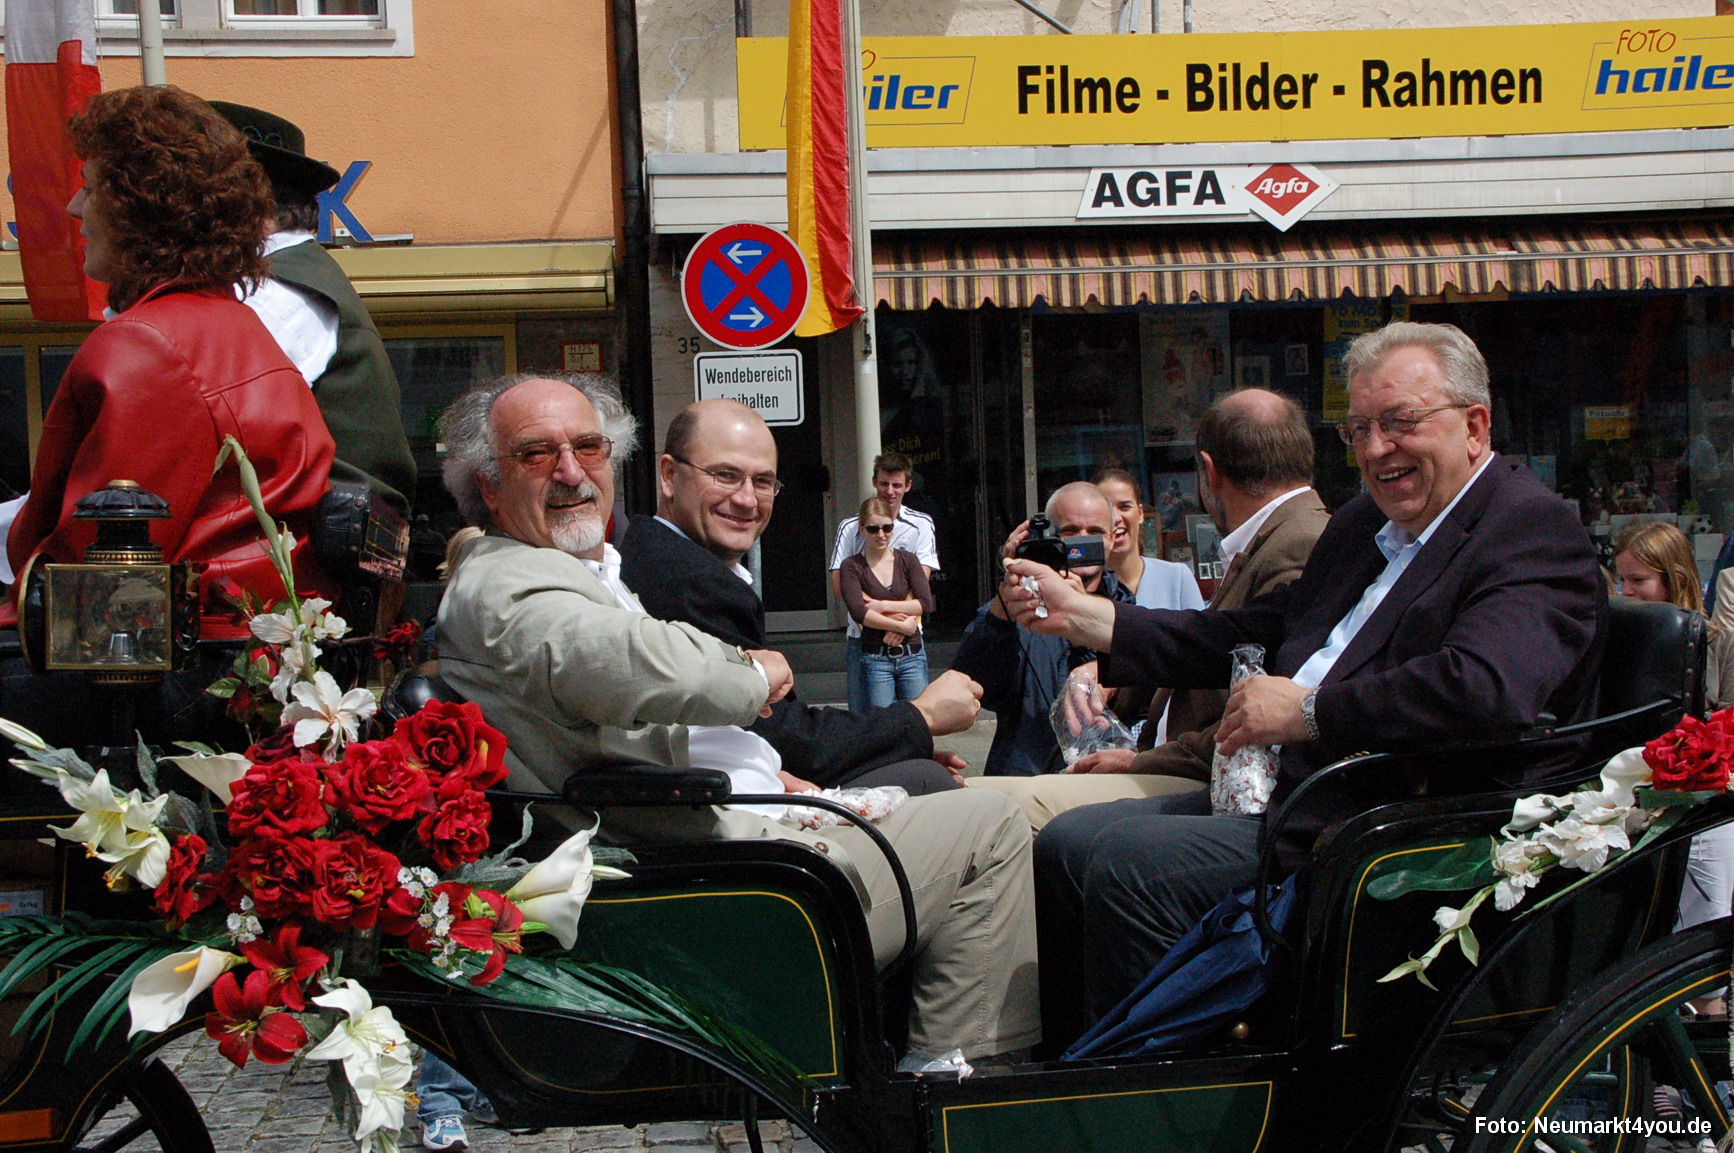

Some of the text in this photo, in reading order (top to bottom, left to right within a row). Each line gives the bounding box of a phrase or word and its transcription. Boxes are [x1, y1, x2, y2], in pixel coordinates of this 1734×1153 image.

[1616, 29, 1676, 54] FOTO
[1018, 65, 1141, 114] Filme
[1186, 61, 1319, 112] Bilder
[1362, 58, 1542, 108] Rahmen
[1594, 55, 1734, 95] haile
[863, 75, 959, 110] iler
[1091, 170, 1226, 208] AGFA
[1253, 177, 1309, 199] Agfa
[678, 336, 700, 353] 35
[705, 366, 792, 384] Wendebereich
